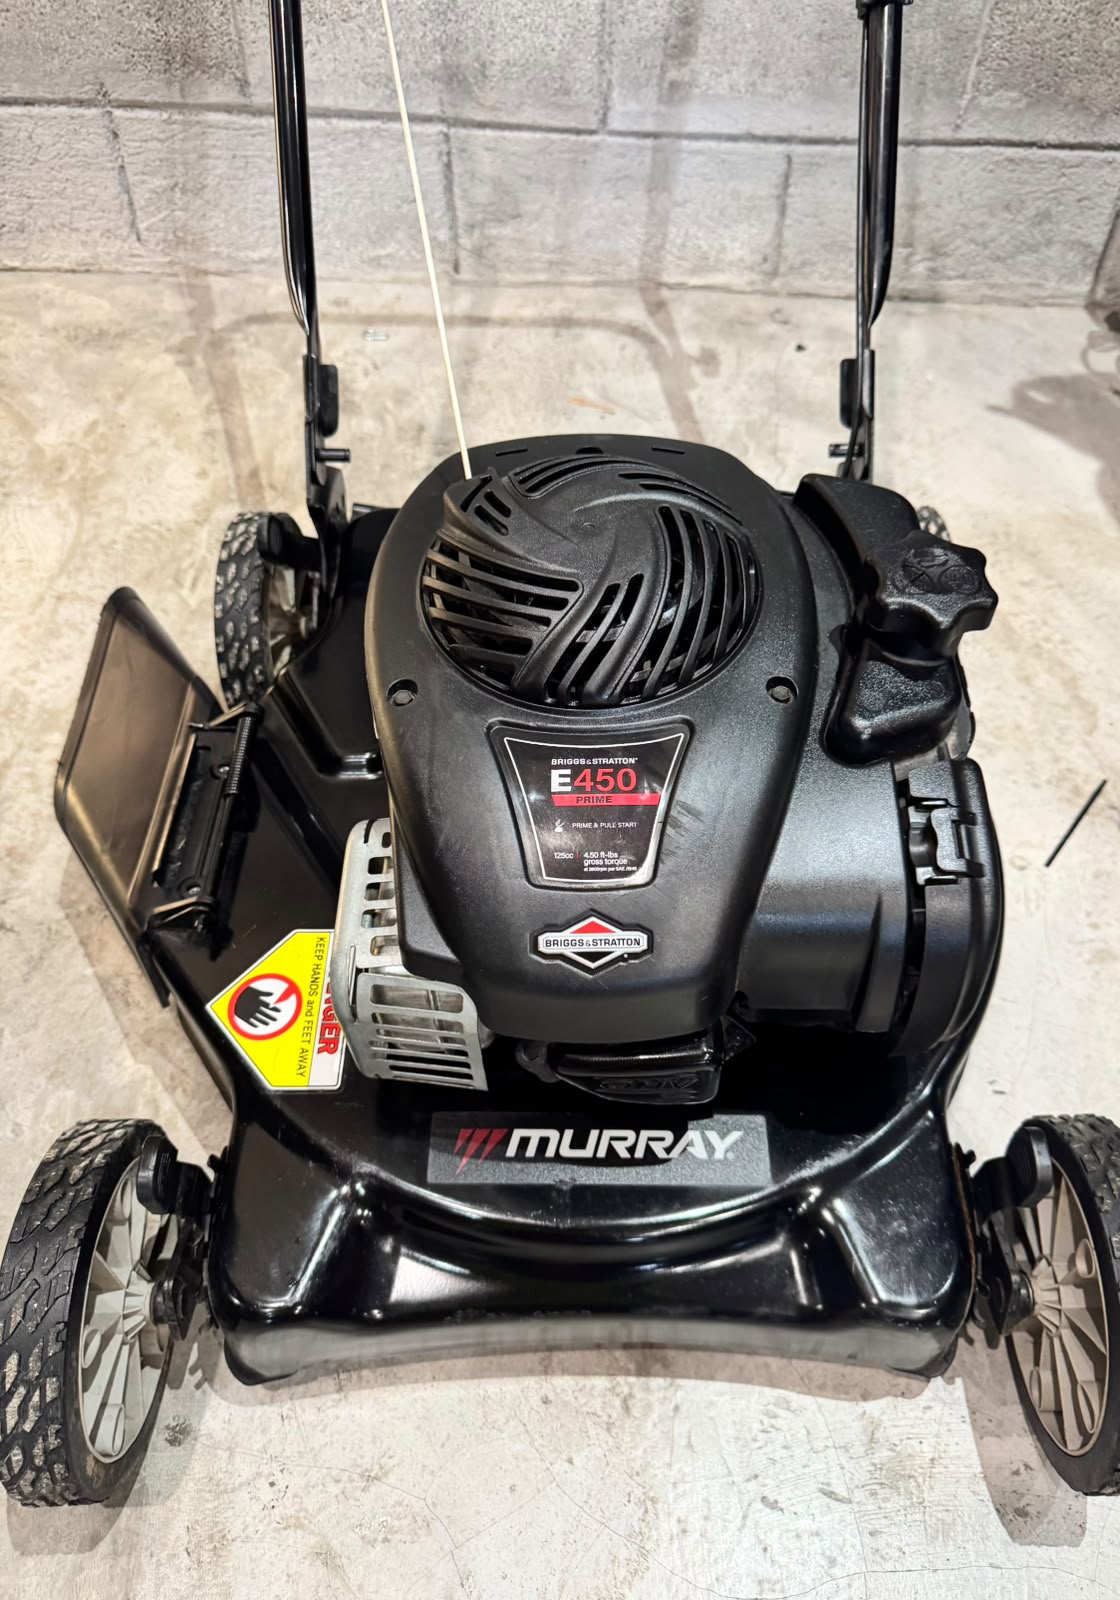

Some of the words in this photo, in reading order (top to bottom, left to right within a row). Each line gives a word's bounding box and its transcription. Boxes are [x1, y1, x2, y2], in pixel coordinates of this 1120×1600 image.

[551, 768, 637, 792] E450
[575, 795, 613, 804] PRIME
[617, 821, 637, 829] START
[604, 859, 628, 867] torque
[315, 936, 326, 961] KEEP
[545, 938, 641, 948] BRIGGS&STRATTON
[308, 963, 322, 997] HANDS
[305, 1000, 315, 1018] and
[317, 983, 342, 1056] GER
[301, 1020, 314, 1045] FEET
[296, 1047, 310, 1078] AWAY
[505, 1128, 744, 1160] MURRAY
